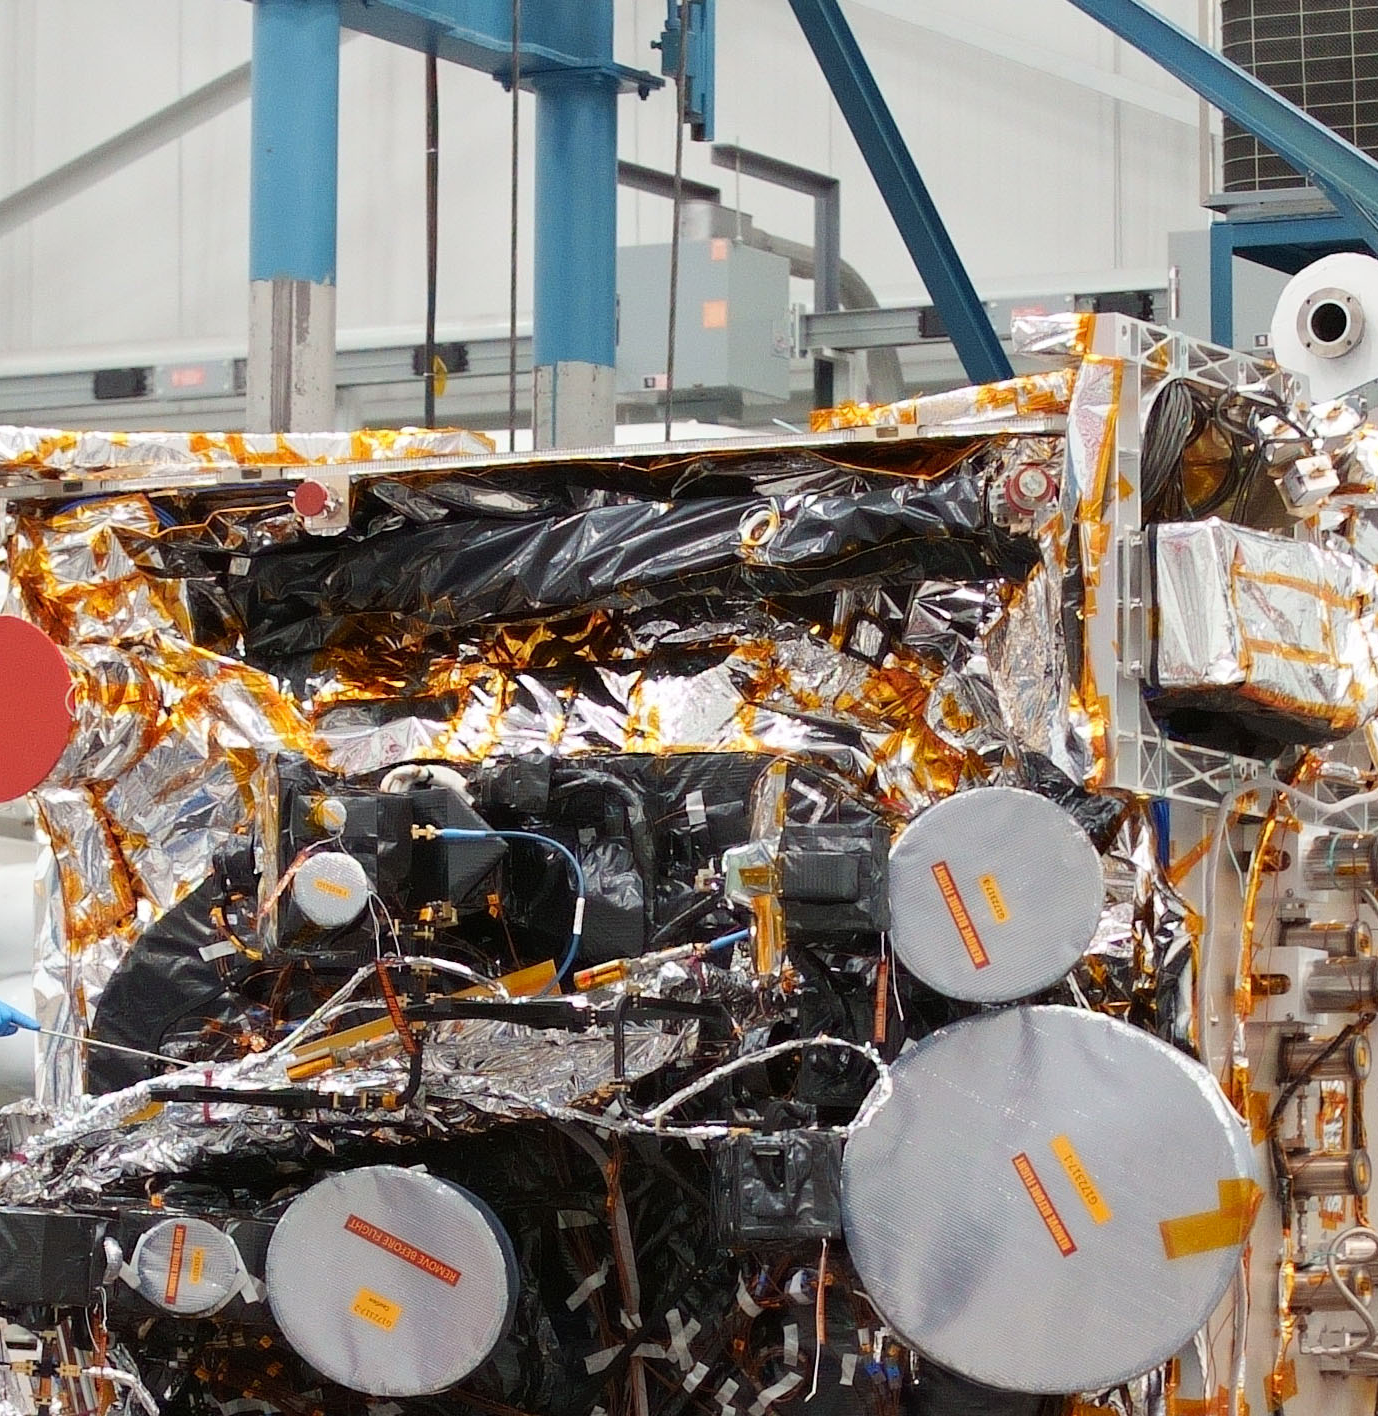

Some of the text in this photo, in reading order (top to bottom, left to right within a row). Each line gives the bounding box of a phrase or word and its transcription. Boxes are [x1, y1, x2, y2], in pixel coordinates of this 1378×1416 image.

[933, 863, 985, 963] REMOVE BEFORE FLIGHT
[1012, 1155, 1072, 1251] REMOVE BEFORE FLIGHT
[1062, 1153, 1099, 1206] G172317-1
[347, 1217, 457, 1281] REMOVE BEFORE FLIGHT
